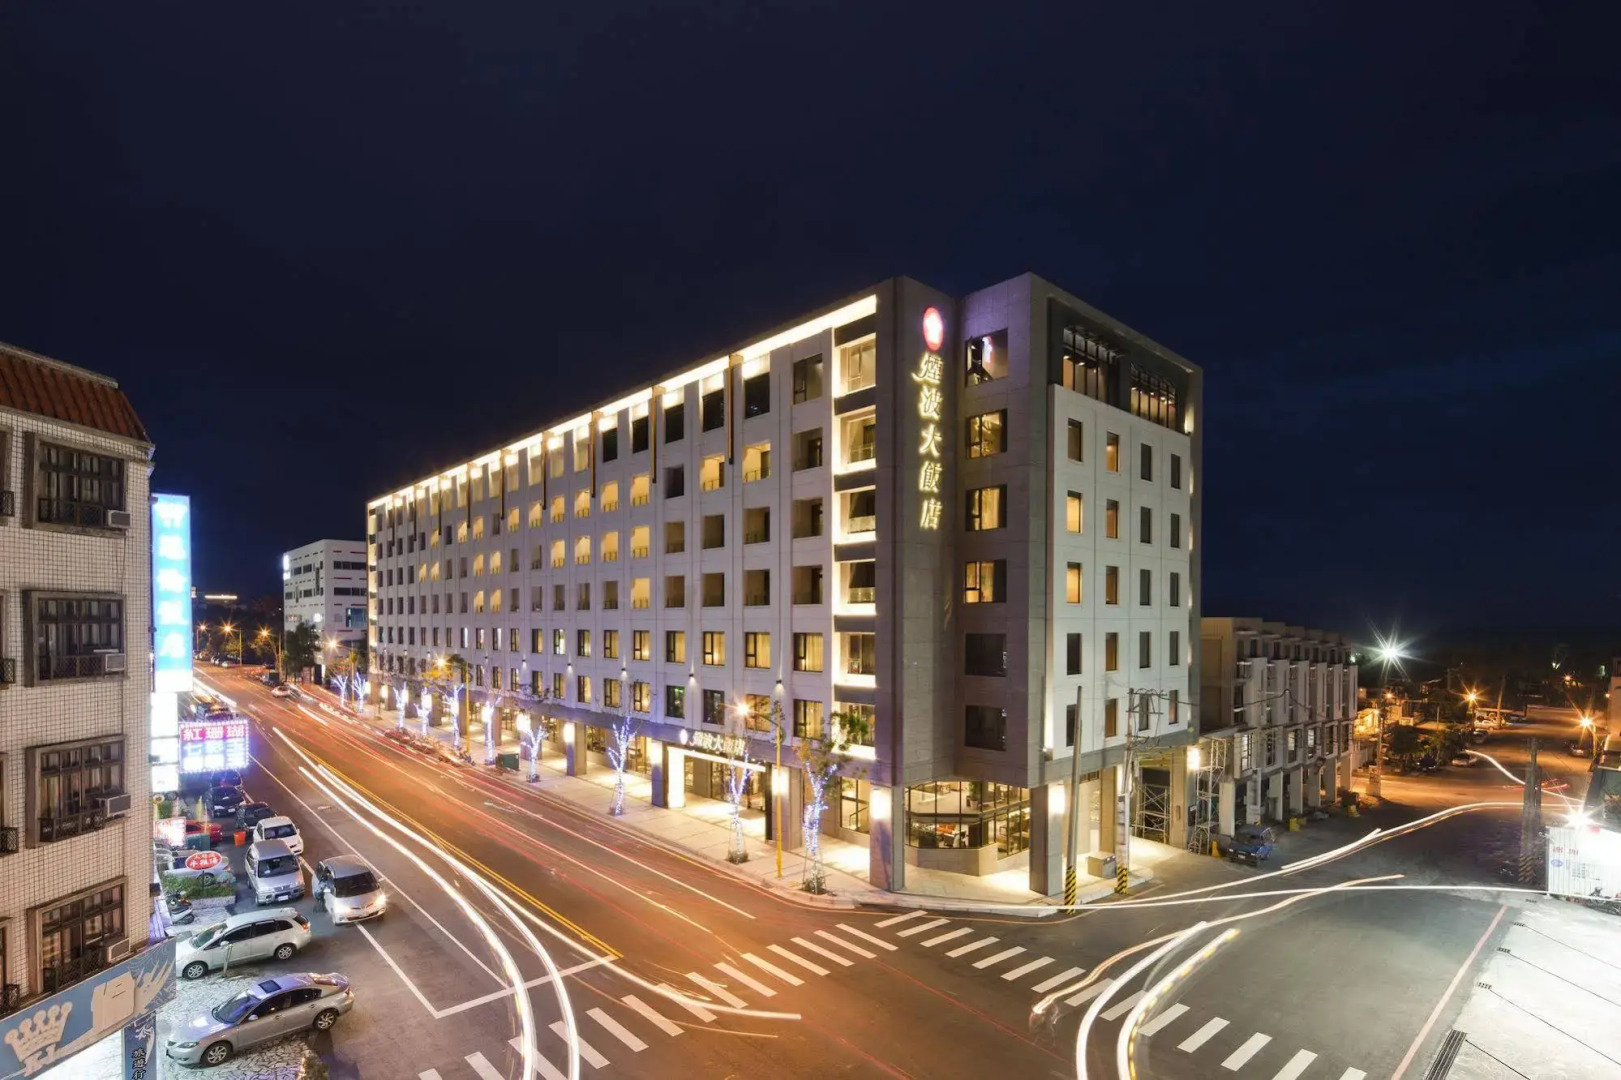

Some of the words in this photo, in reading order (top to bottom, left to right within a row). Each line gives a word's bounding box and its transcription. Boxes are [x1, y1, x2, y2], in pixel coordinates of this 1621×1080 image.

[912, 352, 943, 529] 煙波大飯店
[183, 725, 245, 741] 紅珊瑚
